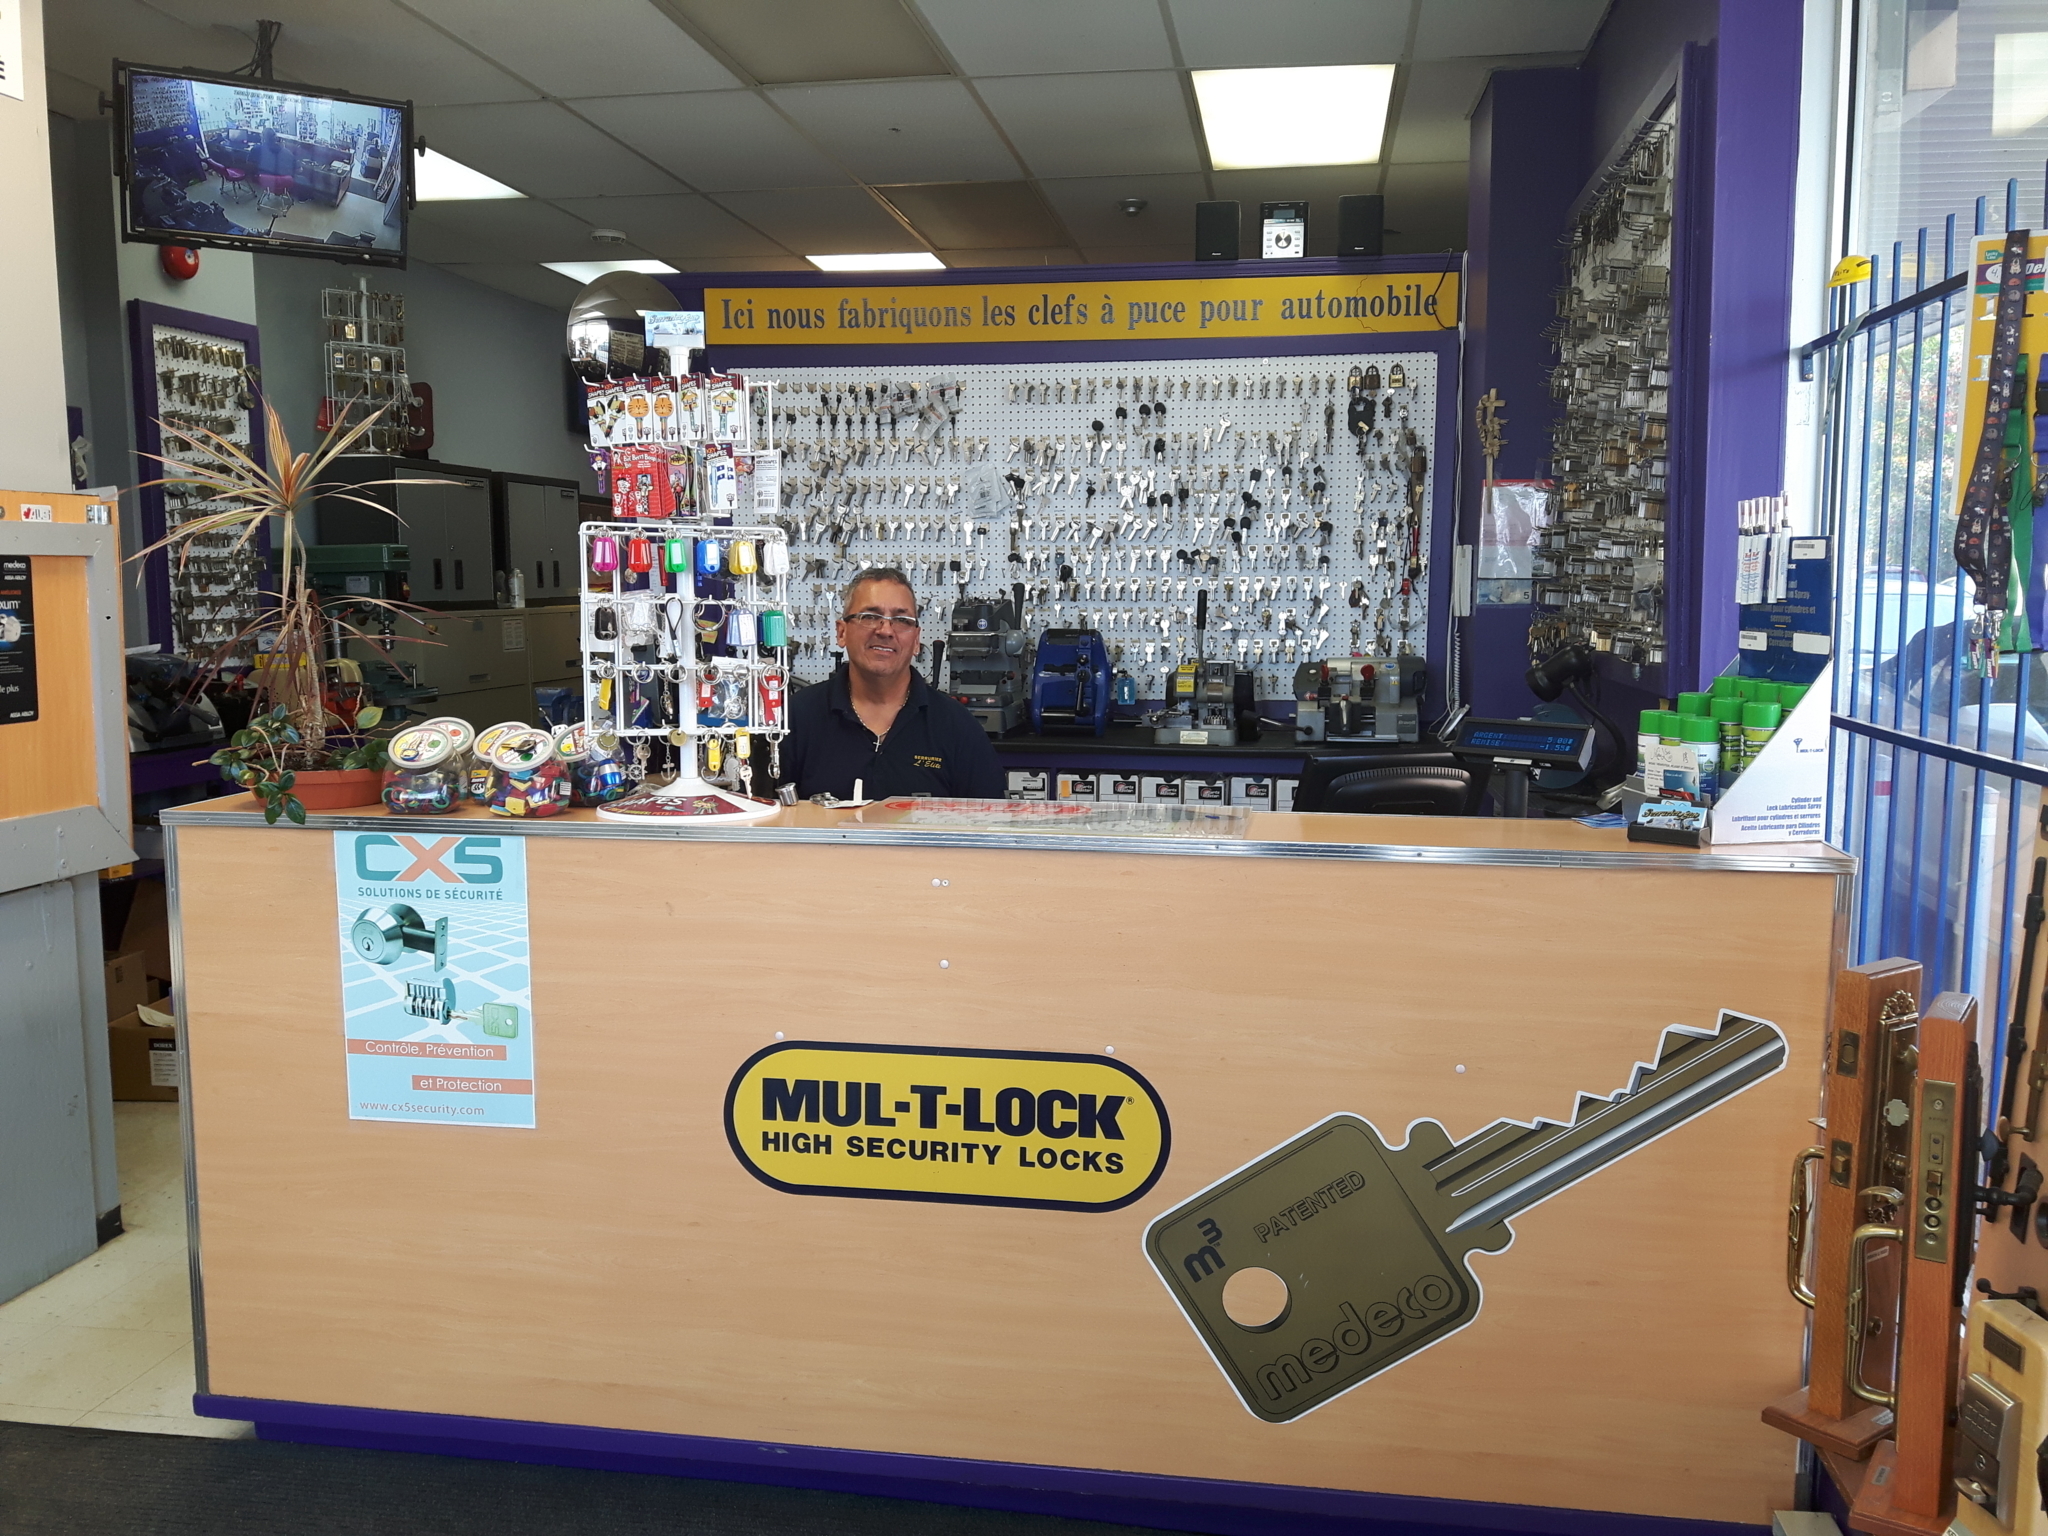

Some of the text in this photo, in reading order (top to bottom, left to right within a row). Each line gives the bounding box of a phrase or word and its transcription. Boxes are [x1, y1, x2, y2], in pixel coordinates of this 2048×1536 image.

[721, 284, 1439, 335] Ici nous fabriquons les clefs à puce pour automobile
[1523, 592, 1530, 600] 5
[6, 684, 19, 694] plus
[354, 834, 503, 884] CX5
[358, 886, 503, 901] SOLUTIONS DE SÉCURITÉ
[365, 1040, 494, 1058] Contrôle, Prévention
[420, 1078, 502, 1092] et Protection
[359, 1100, 485, 1116] www.cx5security.com
[761, 1131, 1125, 1175] HIGH SECURITY LOCKS
[1253, 1170, 1367, 1244] PATENTED
[1256, 1274, 1455, 1401] medeco
